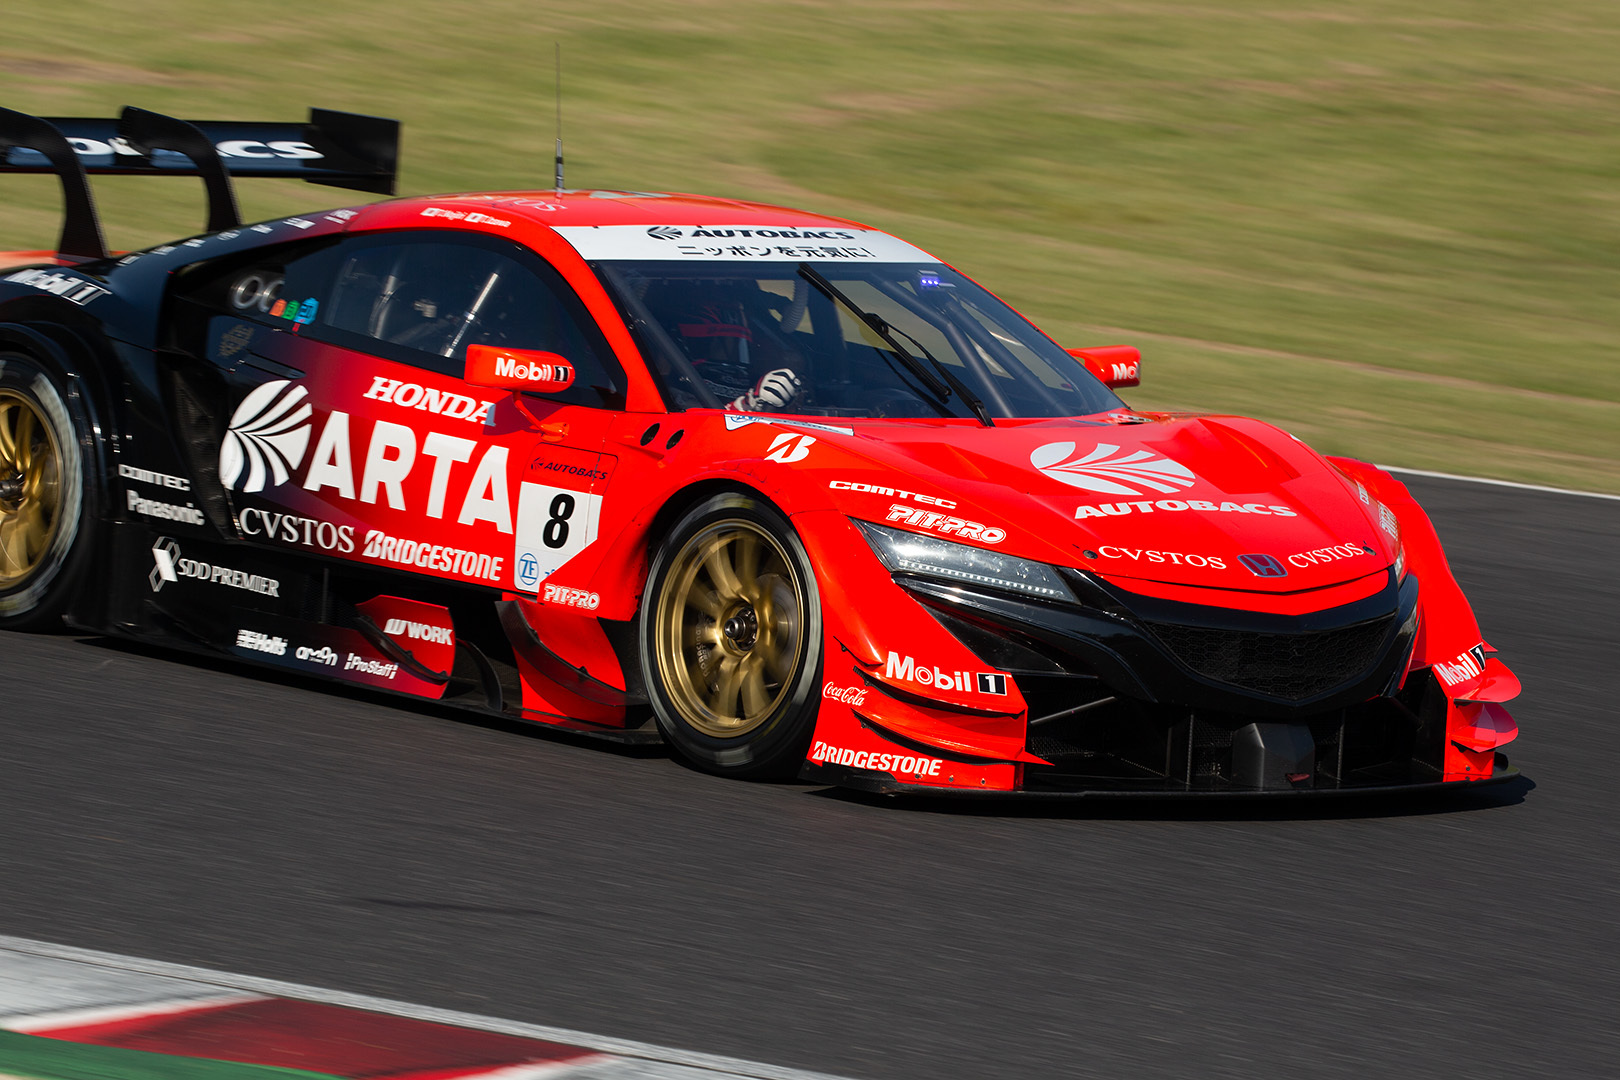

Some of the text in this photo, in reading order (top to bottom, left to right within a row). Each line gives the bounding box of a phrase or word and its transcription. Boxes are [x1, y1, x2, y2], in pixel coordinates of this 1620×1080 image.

[691, 229, 855, 240] AUTOBACS
[677, 245, 876, 258] ニッポンを元気に!
[495, 357, 552, 381] Mobil
[363, 376, 496, 427] HONDA
[303, 410, 513, 535] ARTA
[544, 461, 608, 480] AUTOBACS
[127, 489, 205, 526] Panasonic
[829, 480, 957, 509] COMTEC
[542, 493, 575, 549] 8
[1074, 500, 1298, 519] AUTOBACS
[239, 507, 355, 553] CVSTOS
[362, 530, 504, 581] BRIDGESTONE
[519, 558, 538, 580] ZF
[1097, 545, 1228, 571] CVSTOS
[1288, 542, 1365, 569] CVSTOS
[177, 558, 280, 598] SDD PREMIER
[407, 621, 453, 645] WORK
[886, 651, 972, 692] Mobil
[1434, 652, 1480, 686] Mobil
[823, 681, 869, 706] Coca-Cola
[811, 741, 943, 776] BRIDGESTONE
